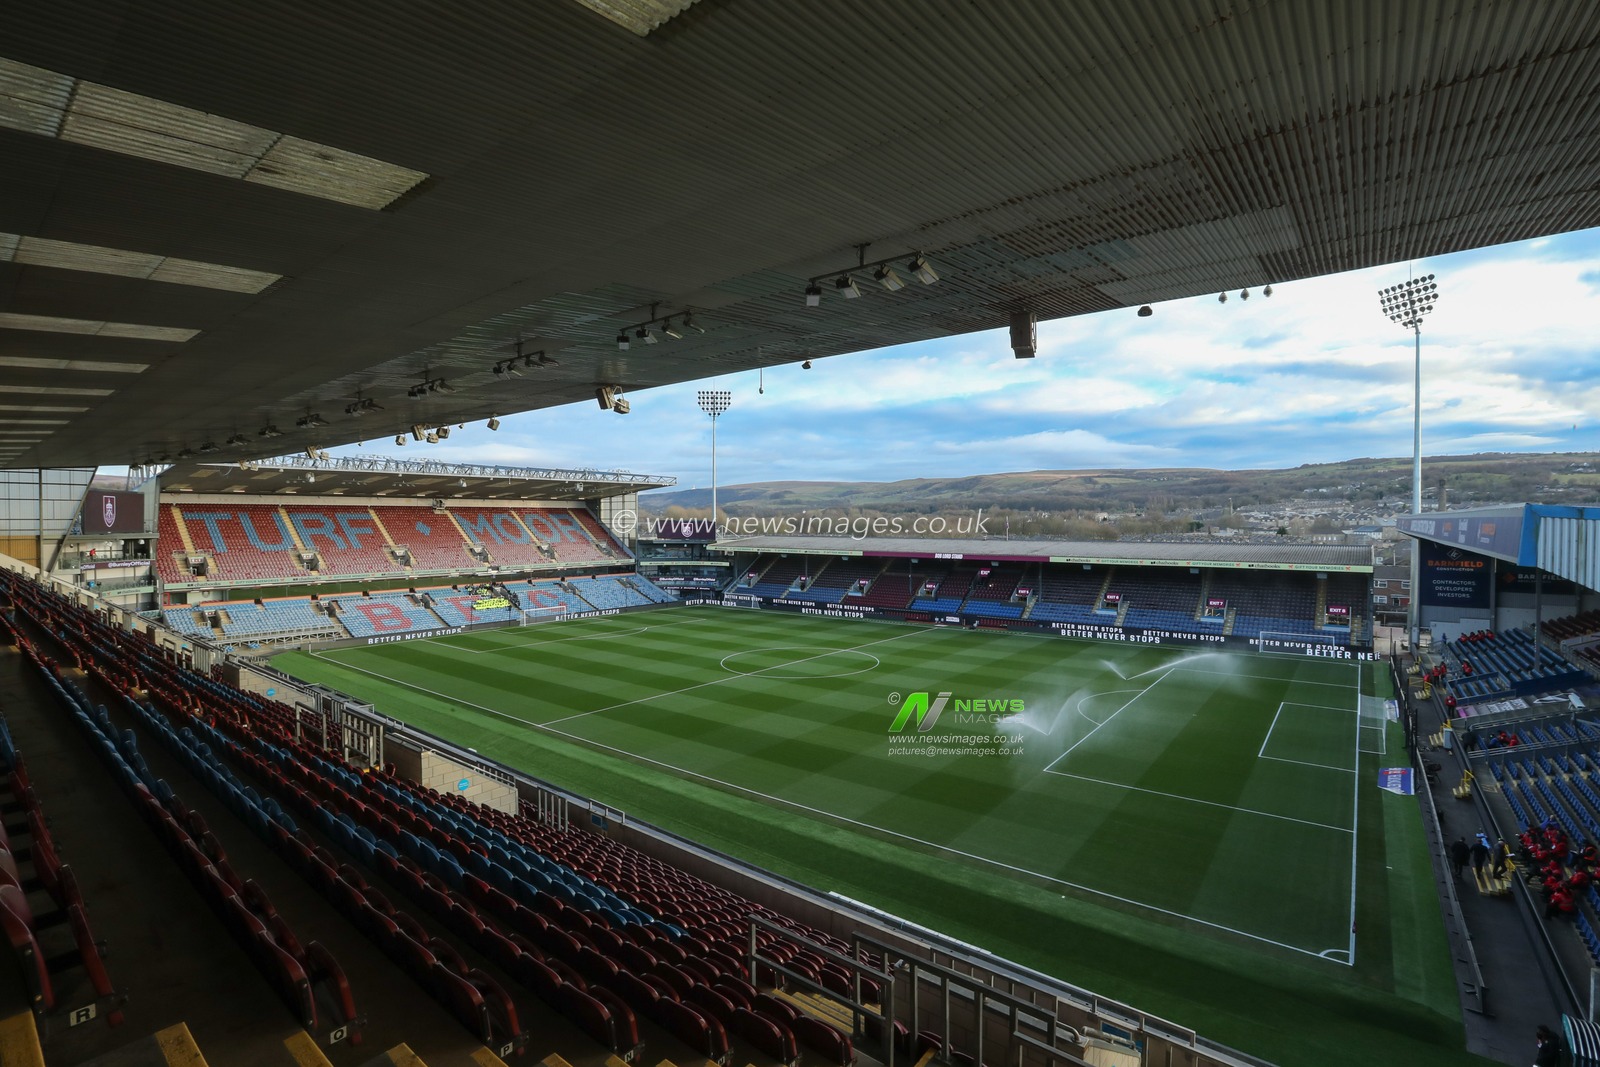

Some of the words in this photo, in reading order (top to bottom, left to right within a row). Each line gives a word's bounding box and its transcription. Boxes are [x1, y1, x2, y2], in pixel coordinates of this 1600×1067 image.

[183, 512, 374, 553] TURF
[453, 513, 595, 545] MOOR
[368, 636, 401, 644] BETTER
[405, 632, 432, 640] NEVER
[1061, 629, 1092, 638] BETTER
[1097, 632, 1126, 640] NEVER
[1130, 634, 1160, 644] STOPS
[1306, 648, 1351, 659] BETTER
[76, 1008, 90, 1024] R
[504, 1046, 509, 1056] P
[626, 1052, 632, 1062] N
